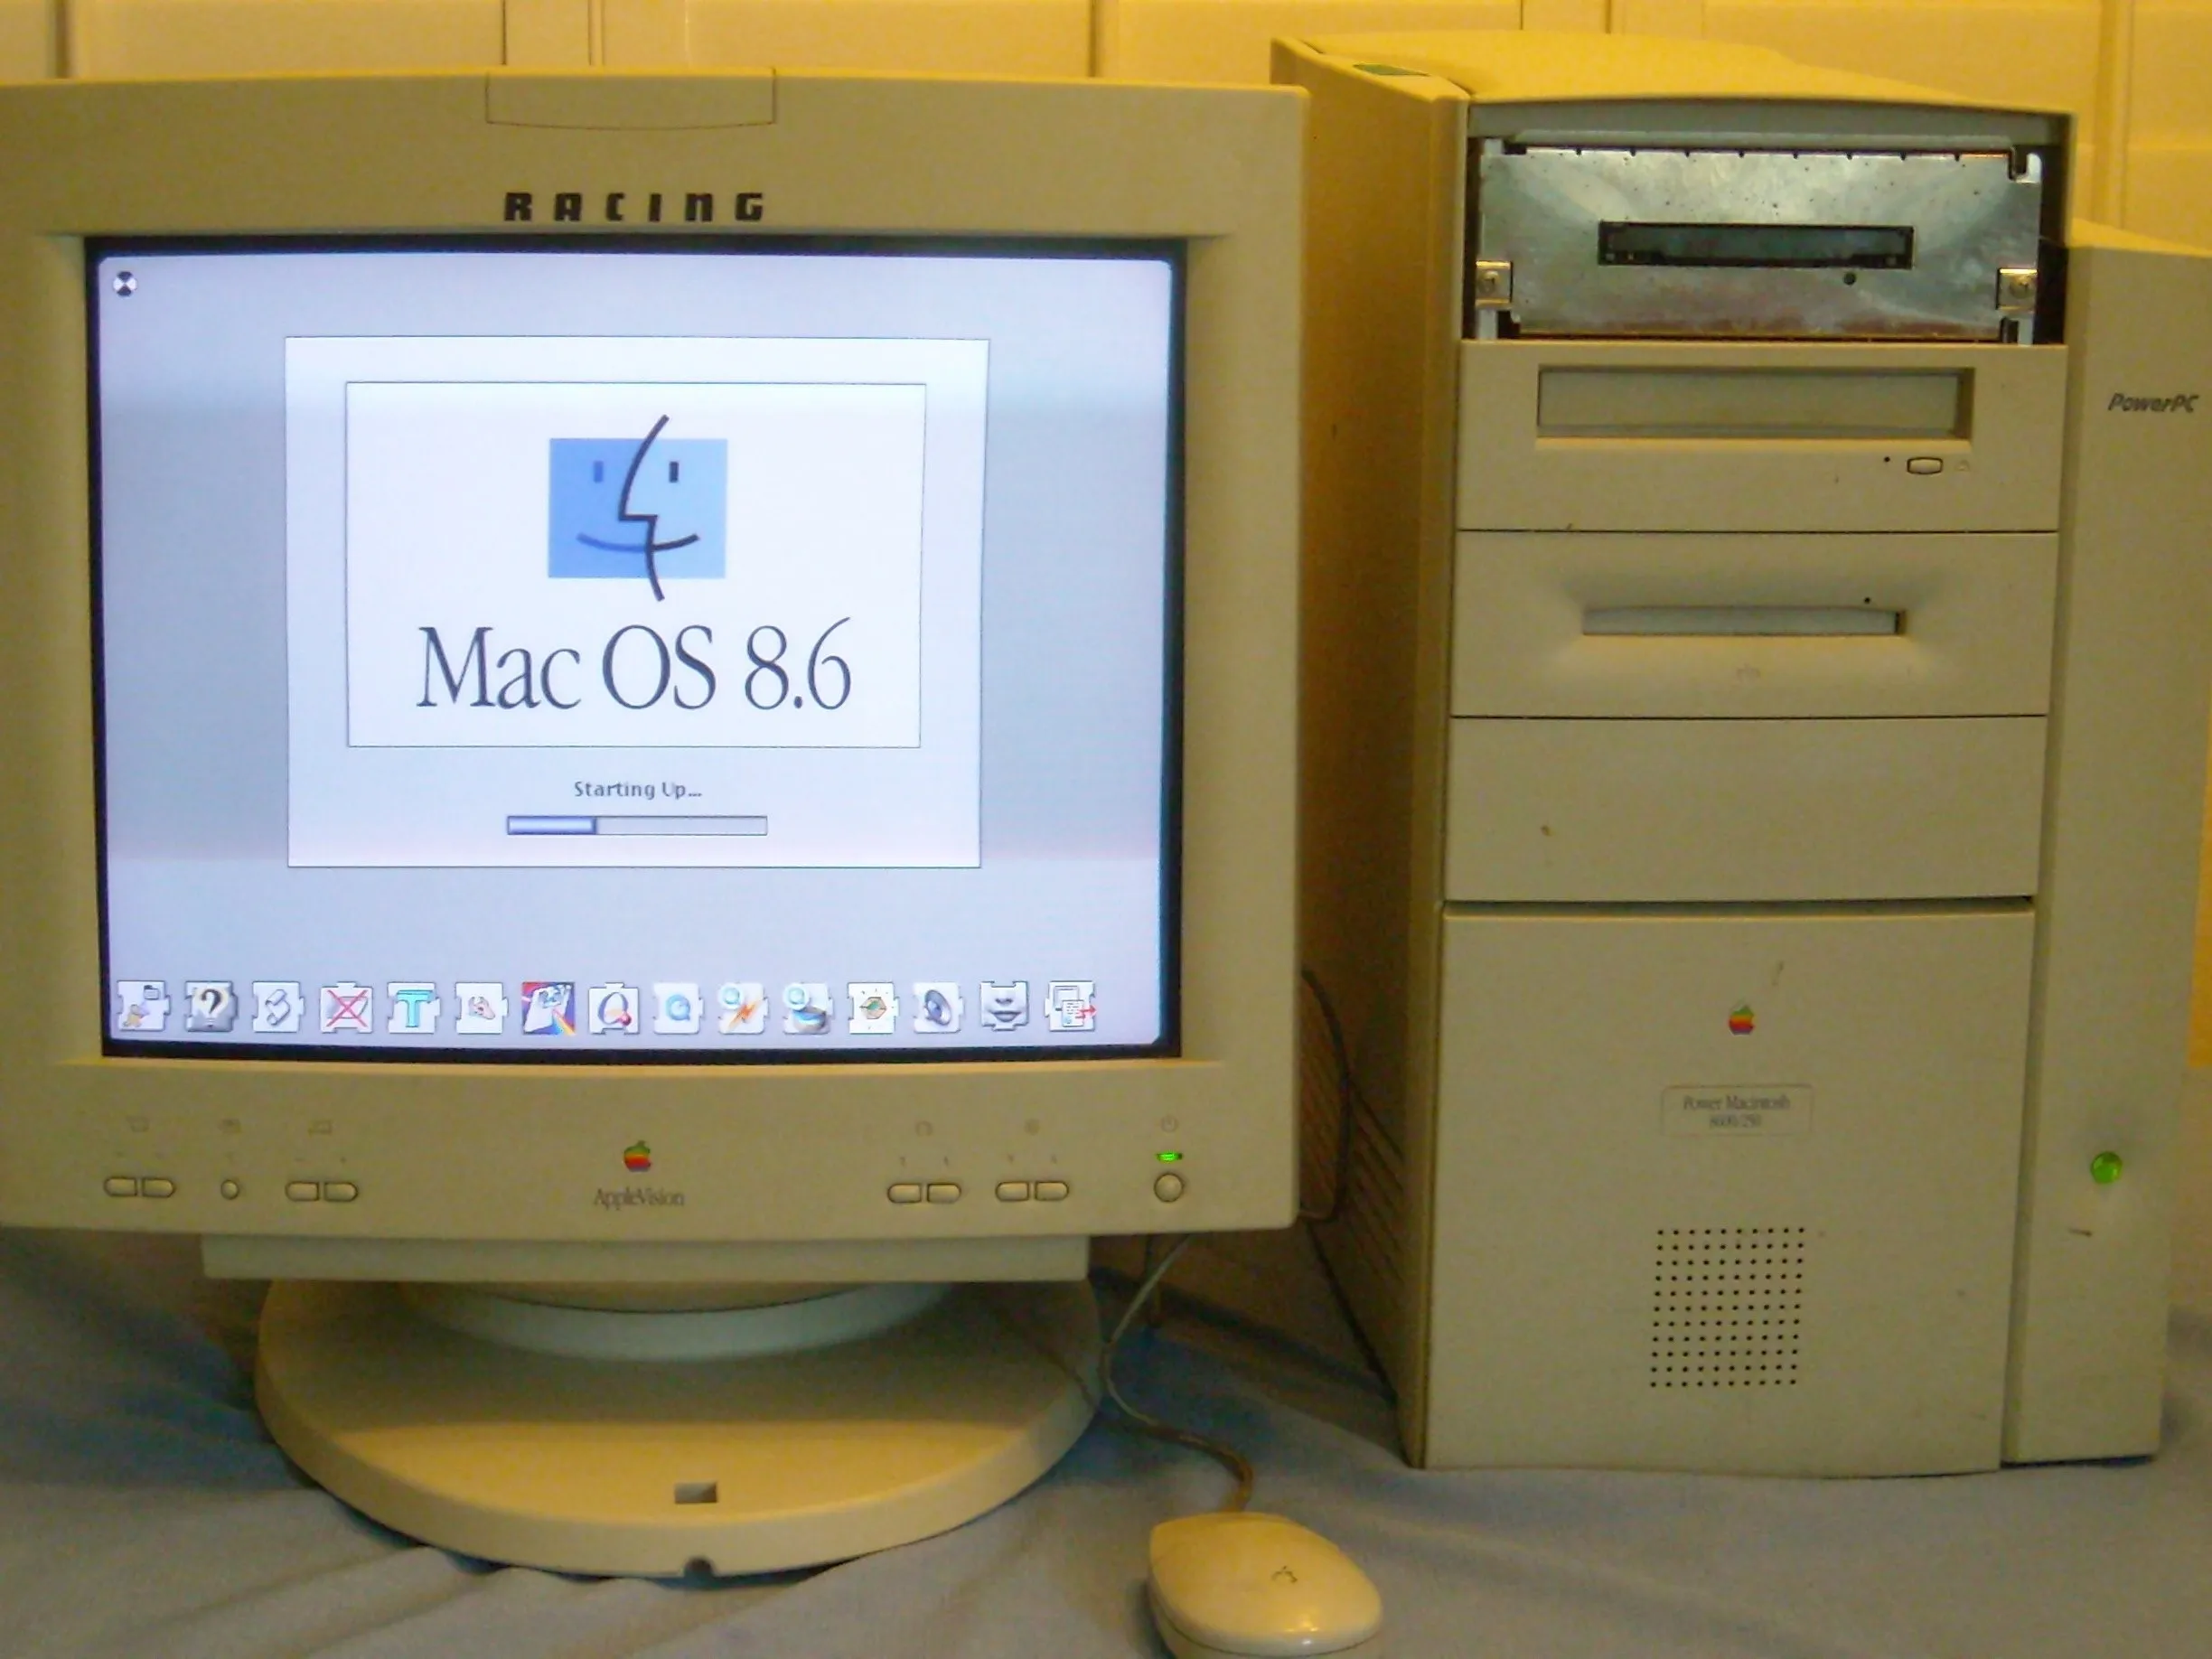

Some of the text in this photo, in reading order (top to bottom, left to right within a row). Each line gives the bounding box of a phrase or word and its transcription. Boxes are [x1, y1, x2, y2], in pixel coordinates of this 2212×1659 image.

[504, 192, 764, 223] RACING
[2107, 392, 2199, 413] PowerPC
[416, 616, 852, 711] Mac OS 8.6
[574, 781, 655, 801] Starting
[1682, 1093, 1792, 1111] Power Macintosh
[594, 1186, 686, 1212] AppleVision
